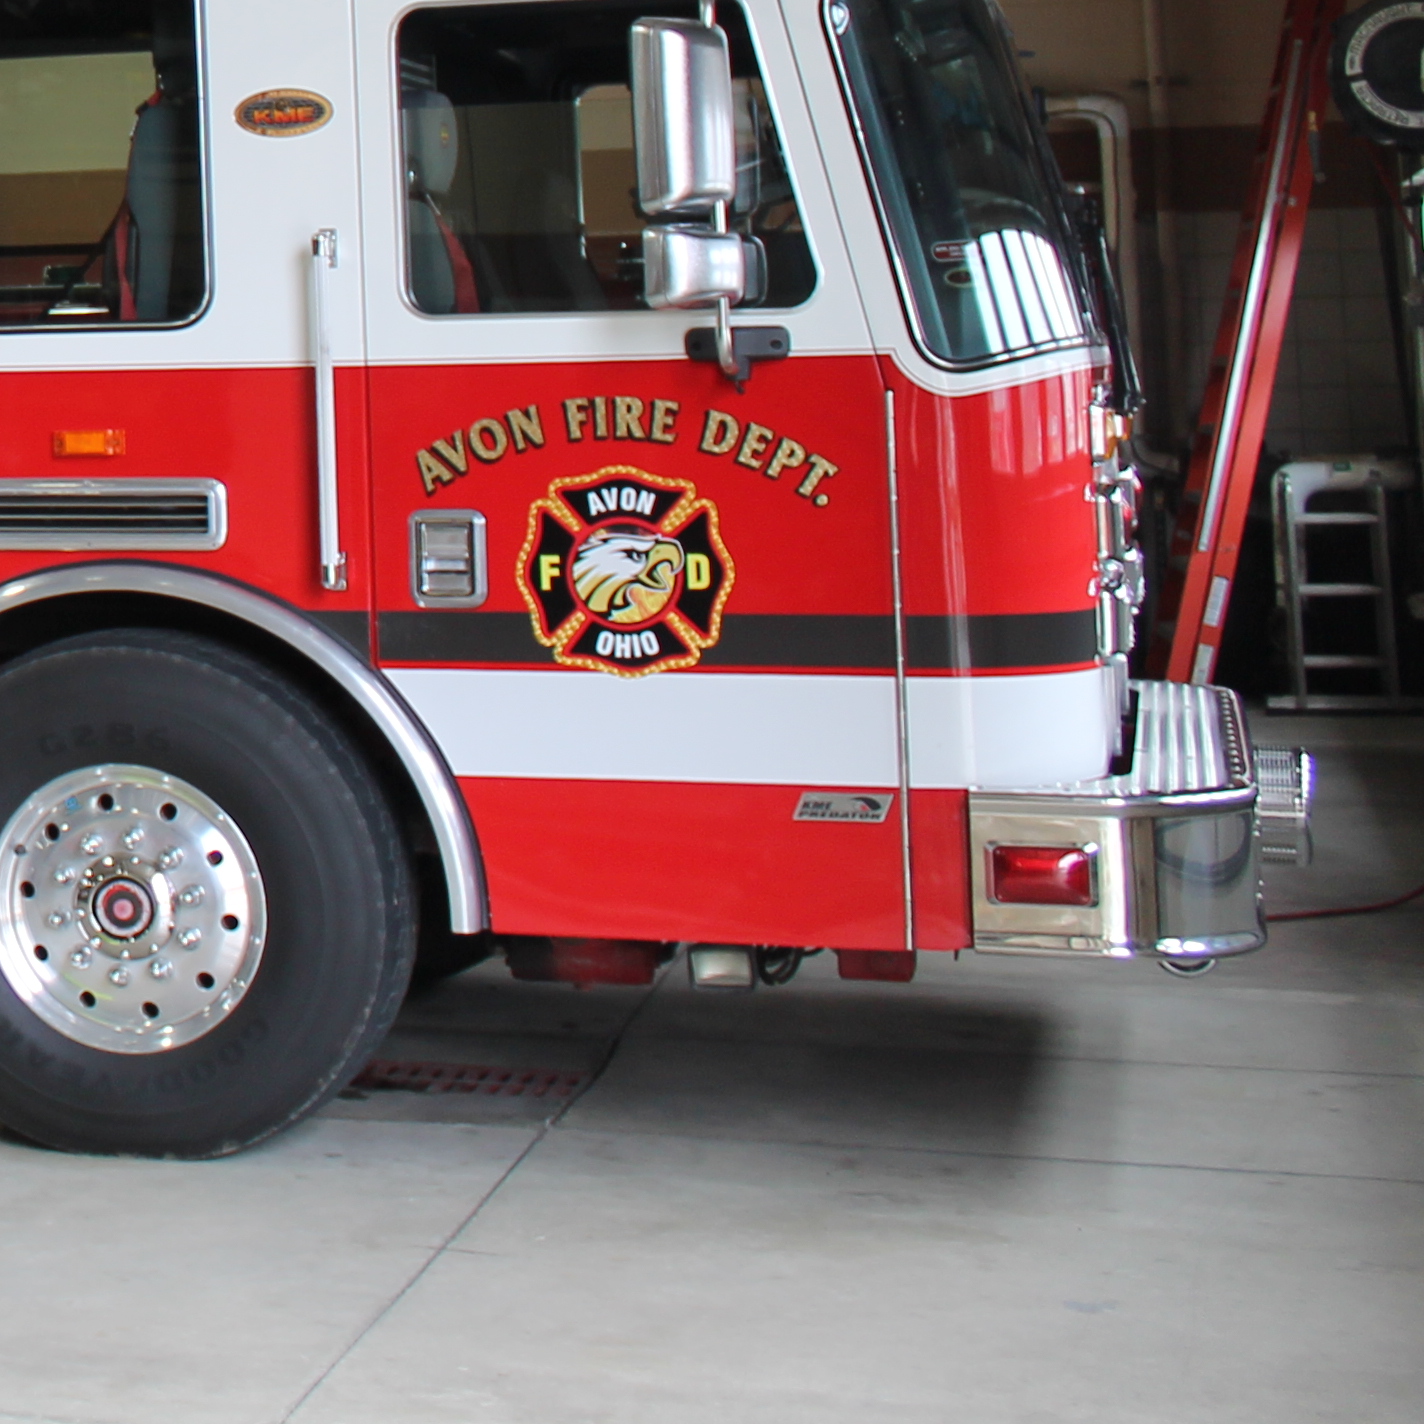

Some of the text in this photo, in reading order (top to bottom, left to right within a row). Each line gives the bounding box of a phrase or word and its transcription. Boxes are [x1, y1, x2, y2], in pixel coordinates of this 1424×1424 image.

[253, 106, 316, 124] KME
[416, 396, 838, 507] AVON FIRE DEPT.
[587, 486, 656, 516] AVON
[540, 554, 560, 591] F
[686, 553, 712, 590] D
[596, 631, 660, 659] OHIO
